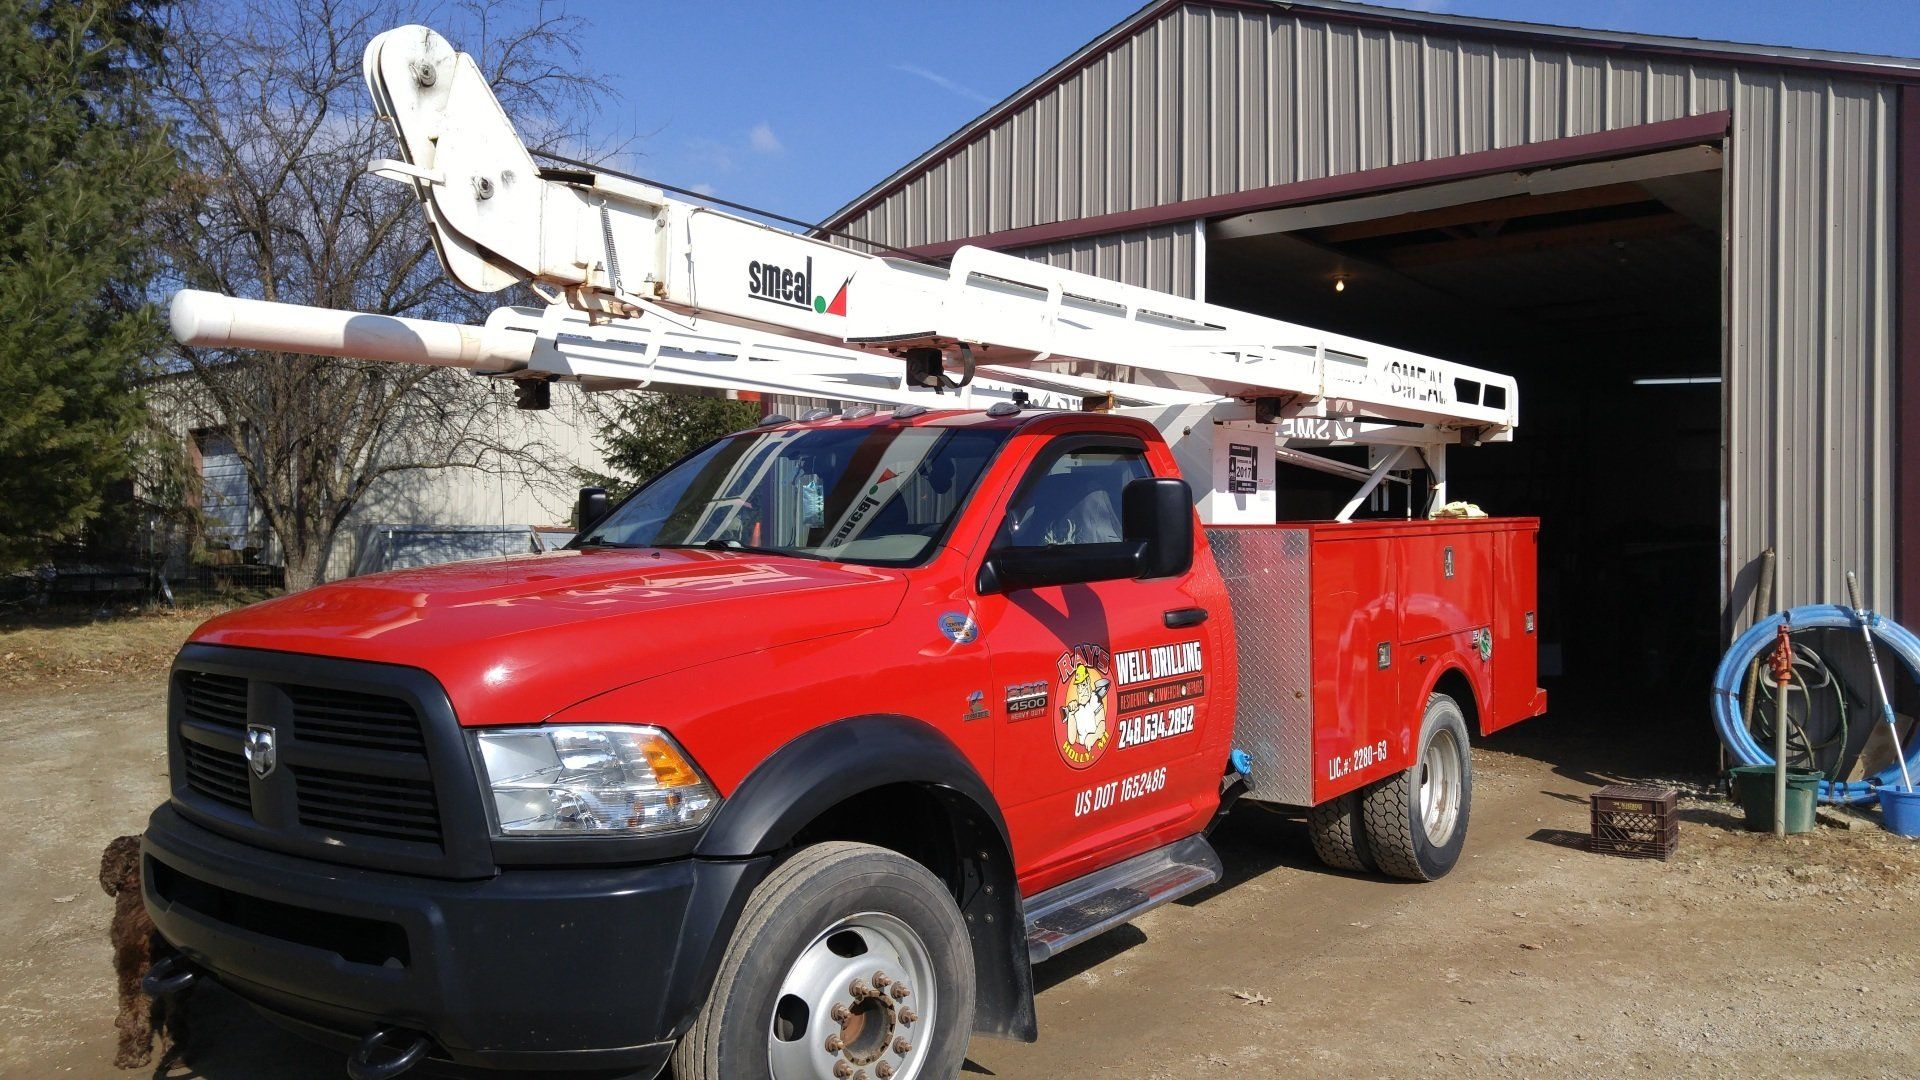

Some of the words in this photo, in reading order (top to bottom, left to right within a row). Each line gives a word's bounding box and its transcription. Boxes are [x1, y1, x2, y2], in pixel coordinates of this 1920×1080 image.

[748, 255, 813, 306] smeal
[1391, 361, 1444, 404] SMEAL
[1236, 466, 1252, 479] 2017
[1115, 649, 1151, 685] WELL
[1150, 641, 1202, 680] DRILLING
[1009, 697, 1047, 712] 4500
[1030, 708, 1046, 717] DUTY
[1118, 704, 1194, 749] 248.634.2892
[1353, 740, 1387, 771] 2280-63
[1074, 789, 1093, 817] US
[1093, 781, 1119, 811] DOT
[1120, 766, 1167, 803] 1652486
